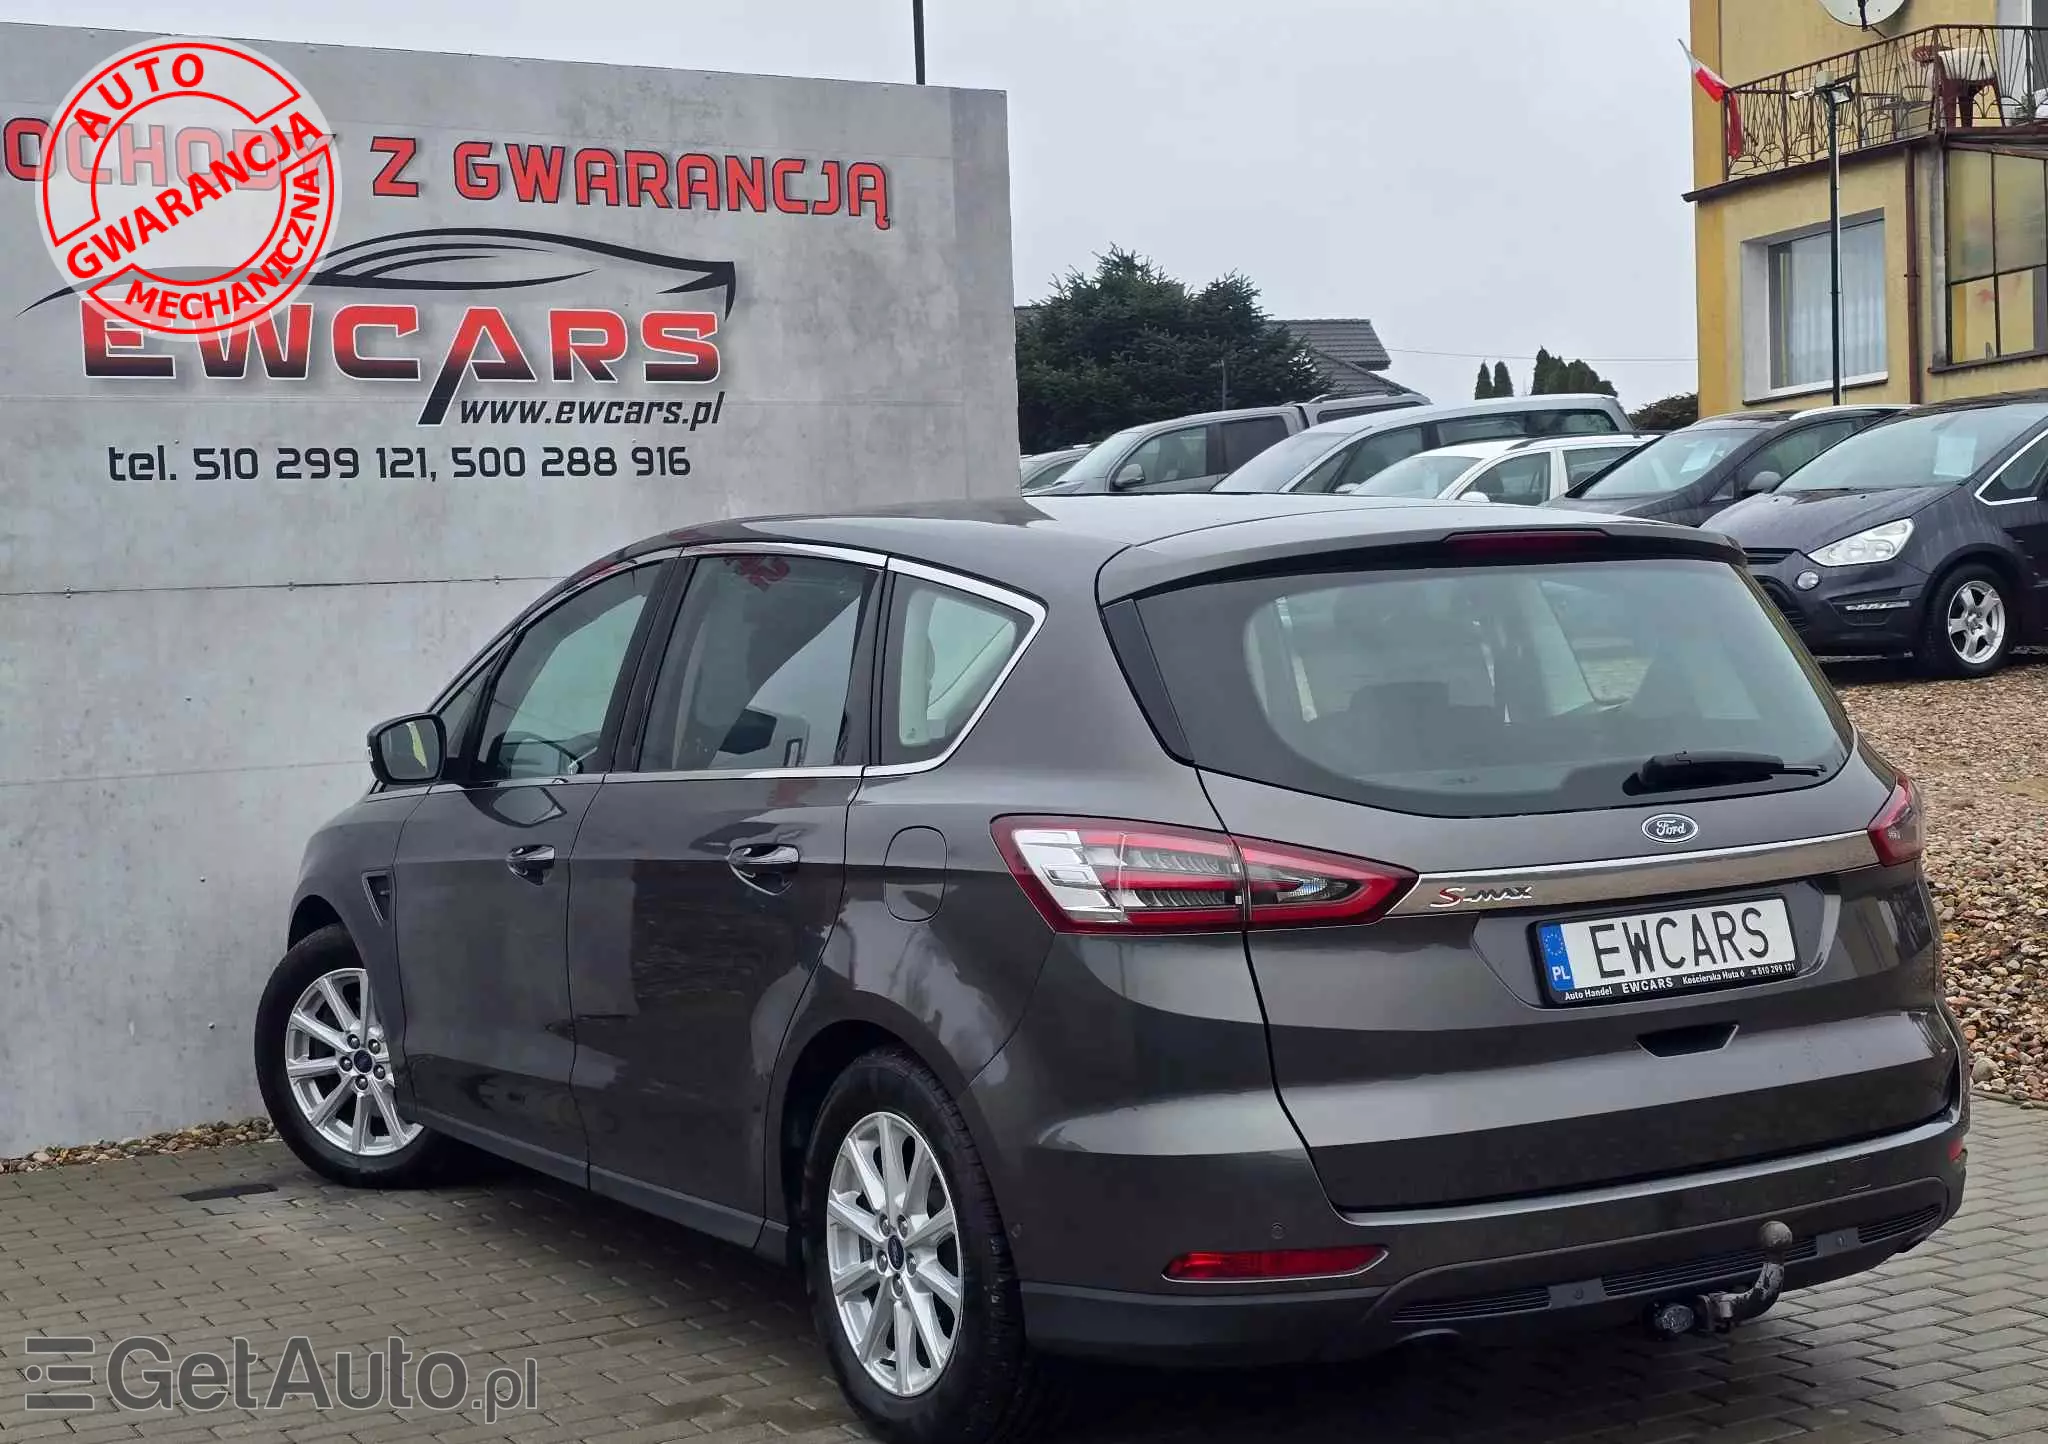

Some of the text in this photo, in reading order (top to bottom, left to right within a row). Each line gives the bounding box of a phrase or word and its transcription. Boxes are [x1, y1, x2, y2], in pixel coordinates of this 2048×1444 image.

[370, 136, 419, 198] Z
[452, 140, 892, 231] GWARANCJĄ
[80, 299, 724, 426] EWCARS
[460, 391, 726, 431] www.ewcars.pl
[108, 445, 691, 482] tel. 510 299 121, 500 288 916
[1656, 819, 1687, 836] Ford
[1589, 906, 1770, 979] EWCARS
[1552, 965, 1571, 981] PL
[1565, 990, 1584, 1001] Auto
[1584, 985, 1613, 998] Handel
[1621, 977, 1674, 994] EWCARS
[1721, 969, 1740, 980] Huta
